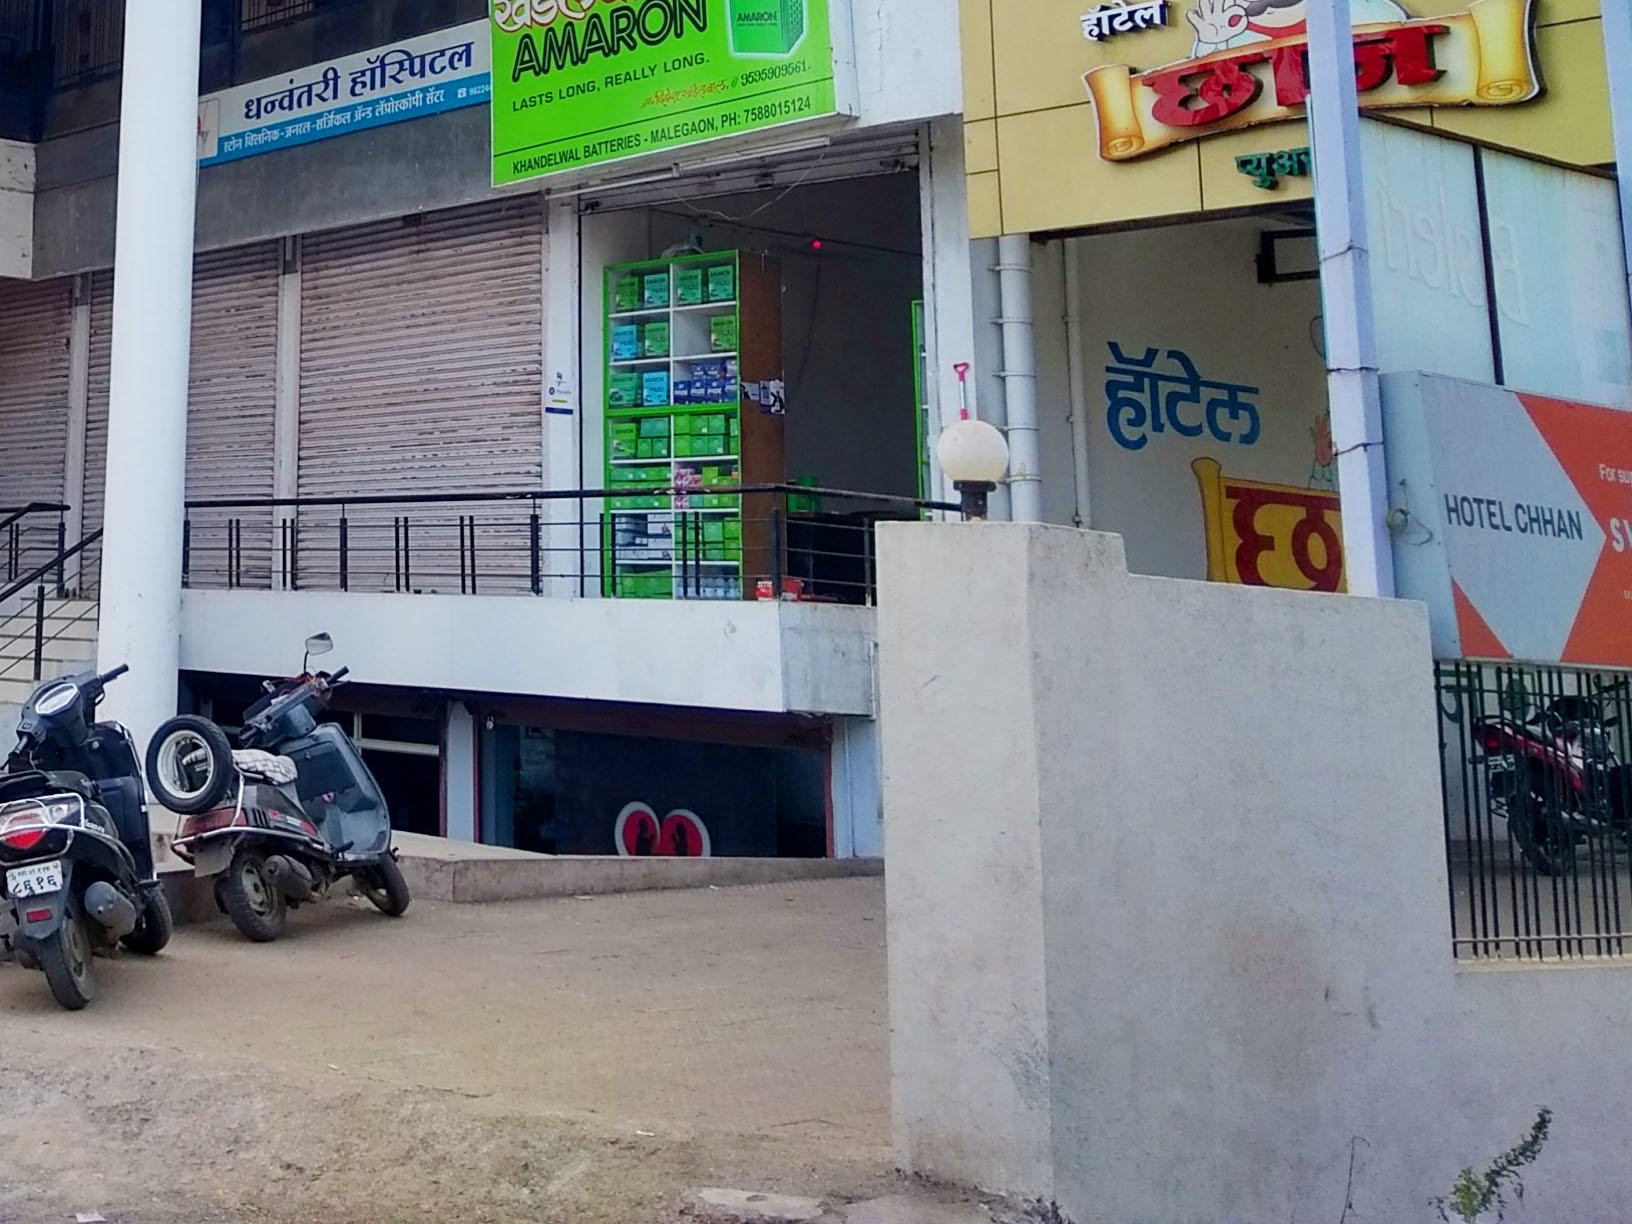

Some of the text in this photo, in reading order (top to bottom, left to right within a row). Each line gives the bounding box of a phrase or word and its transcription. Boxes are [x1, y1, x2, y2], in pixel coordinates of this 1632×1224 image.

[244, 41, 475, 121] धन्वंतरी हॉस्पिटल
[512, 51, 710, 112] LASTS LONG, REALLY LONG.
[512, 147, 582, 176] KHANDELWAL
[583, 132, 641, 159] BATTERIES
[650, 118, 719, 145] MALEGAON,
[721, 111, 741, 130] PH:
[743, 95, 812, 125] 7588015124
[1105, 340, 1260, 451] हॉटेल
[1599, 464, 1616, 482] For
[1444, 493, 1584, 540] HOTEL CHHAN
